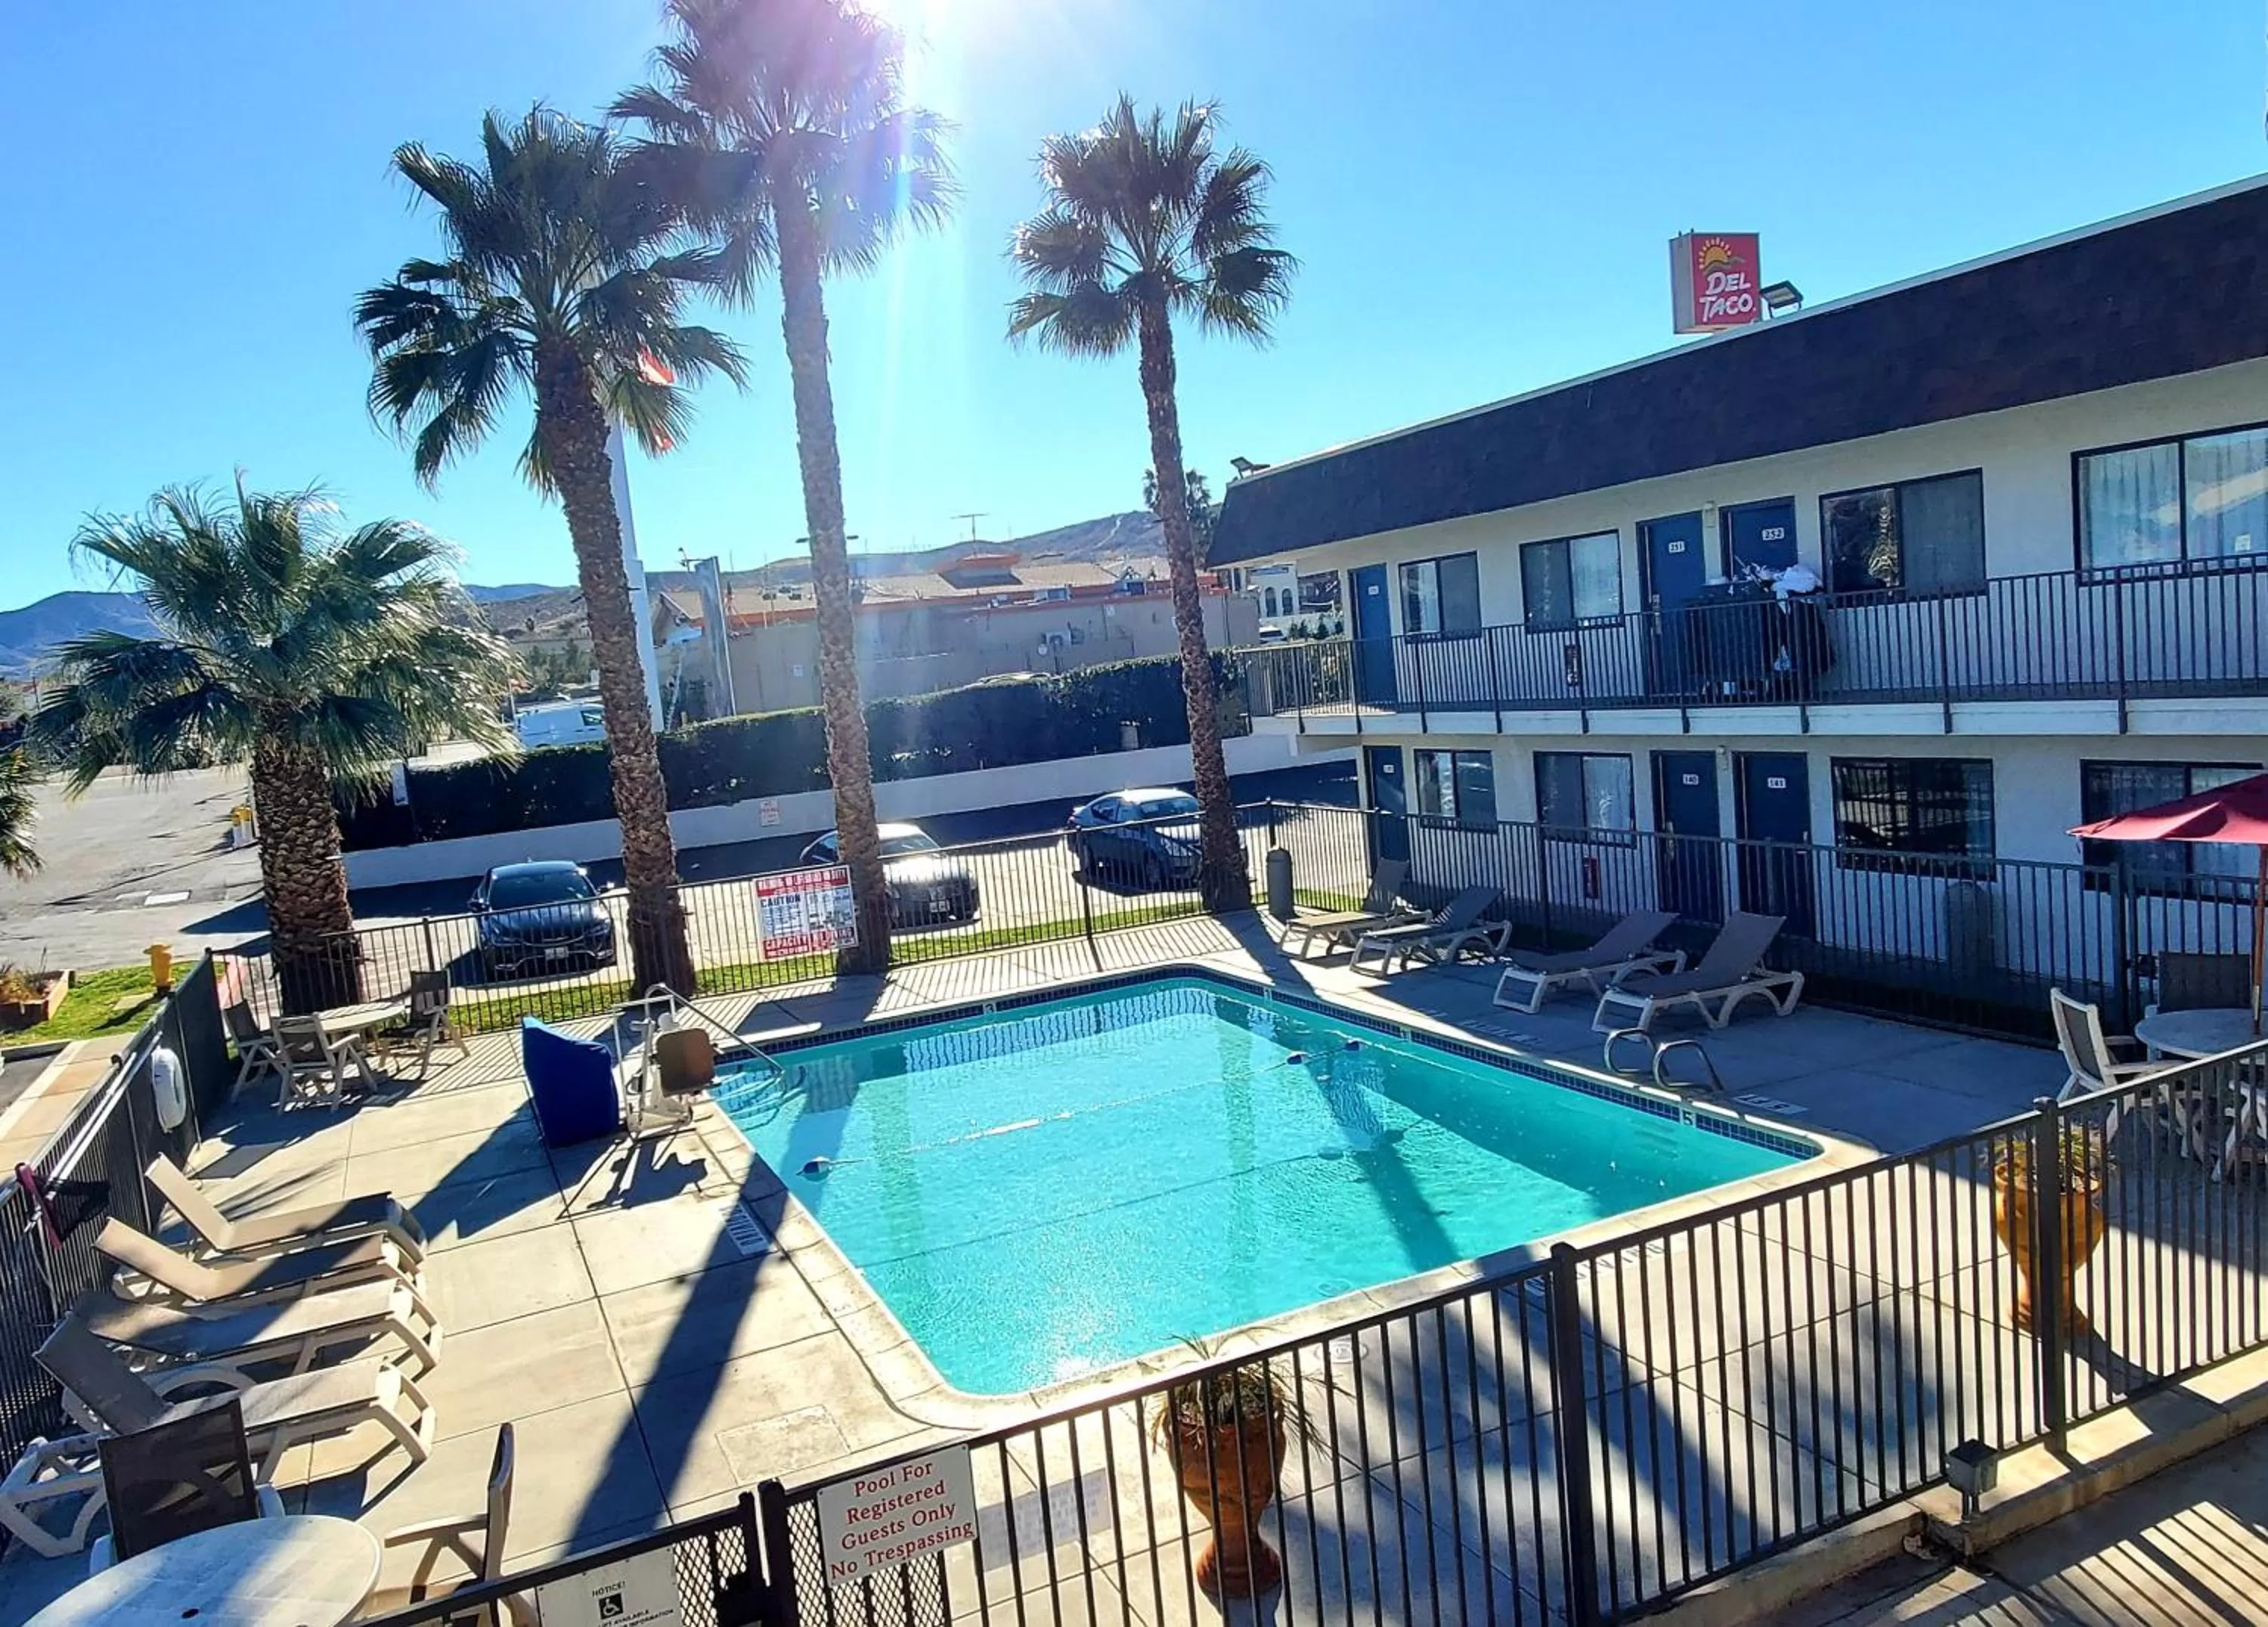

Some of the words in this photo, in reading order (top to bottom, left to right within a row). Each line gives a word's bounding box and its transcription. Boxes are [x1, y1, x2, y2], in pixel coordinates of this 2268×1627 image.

[1706, 272, 1751, 295] DEL
[1699, 293, 1754, 323] TACO
[761, 894, 800, 907] CAUTION
[766, 934, 808, 950] CAPACITY
[1682, 1110, 1693, 1126] 5
[854, 1471, 895, 1498] Pool
[902, 1462, 933, 1483] For
[846, 1480, 946, 1524] Registered
[841, 1519, 905, 1550] Guests
[912, 1503, 956, 1526] Only
[830, 1560, 858, 1579] No
[864, 1521, 975, 1567] Trespassing
[592, 1581, 626, 1597] NOTICE!
